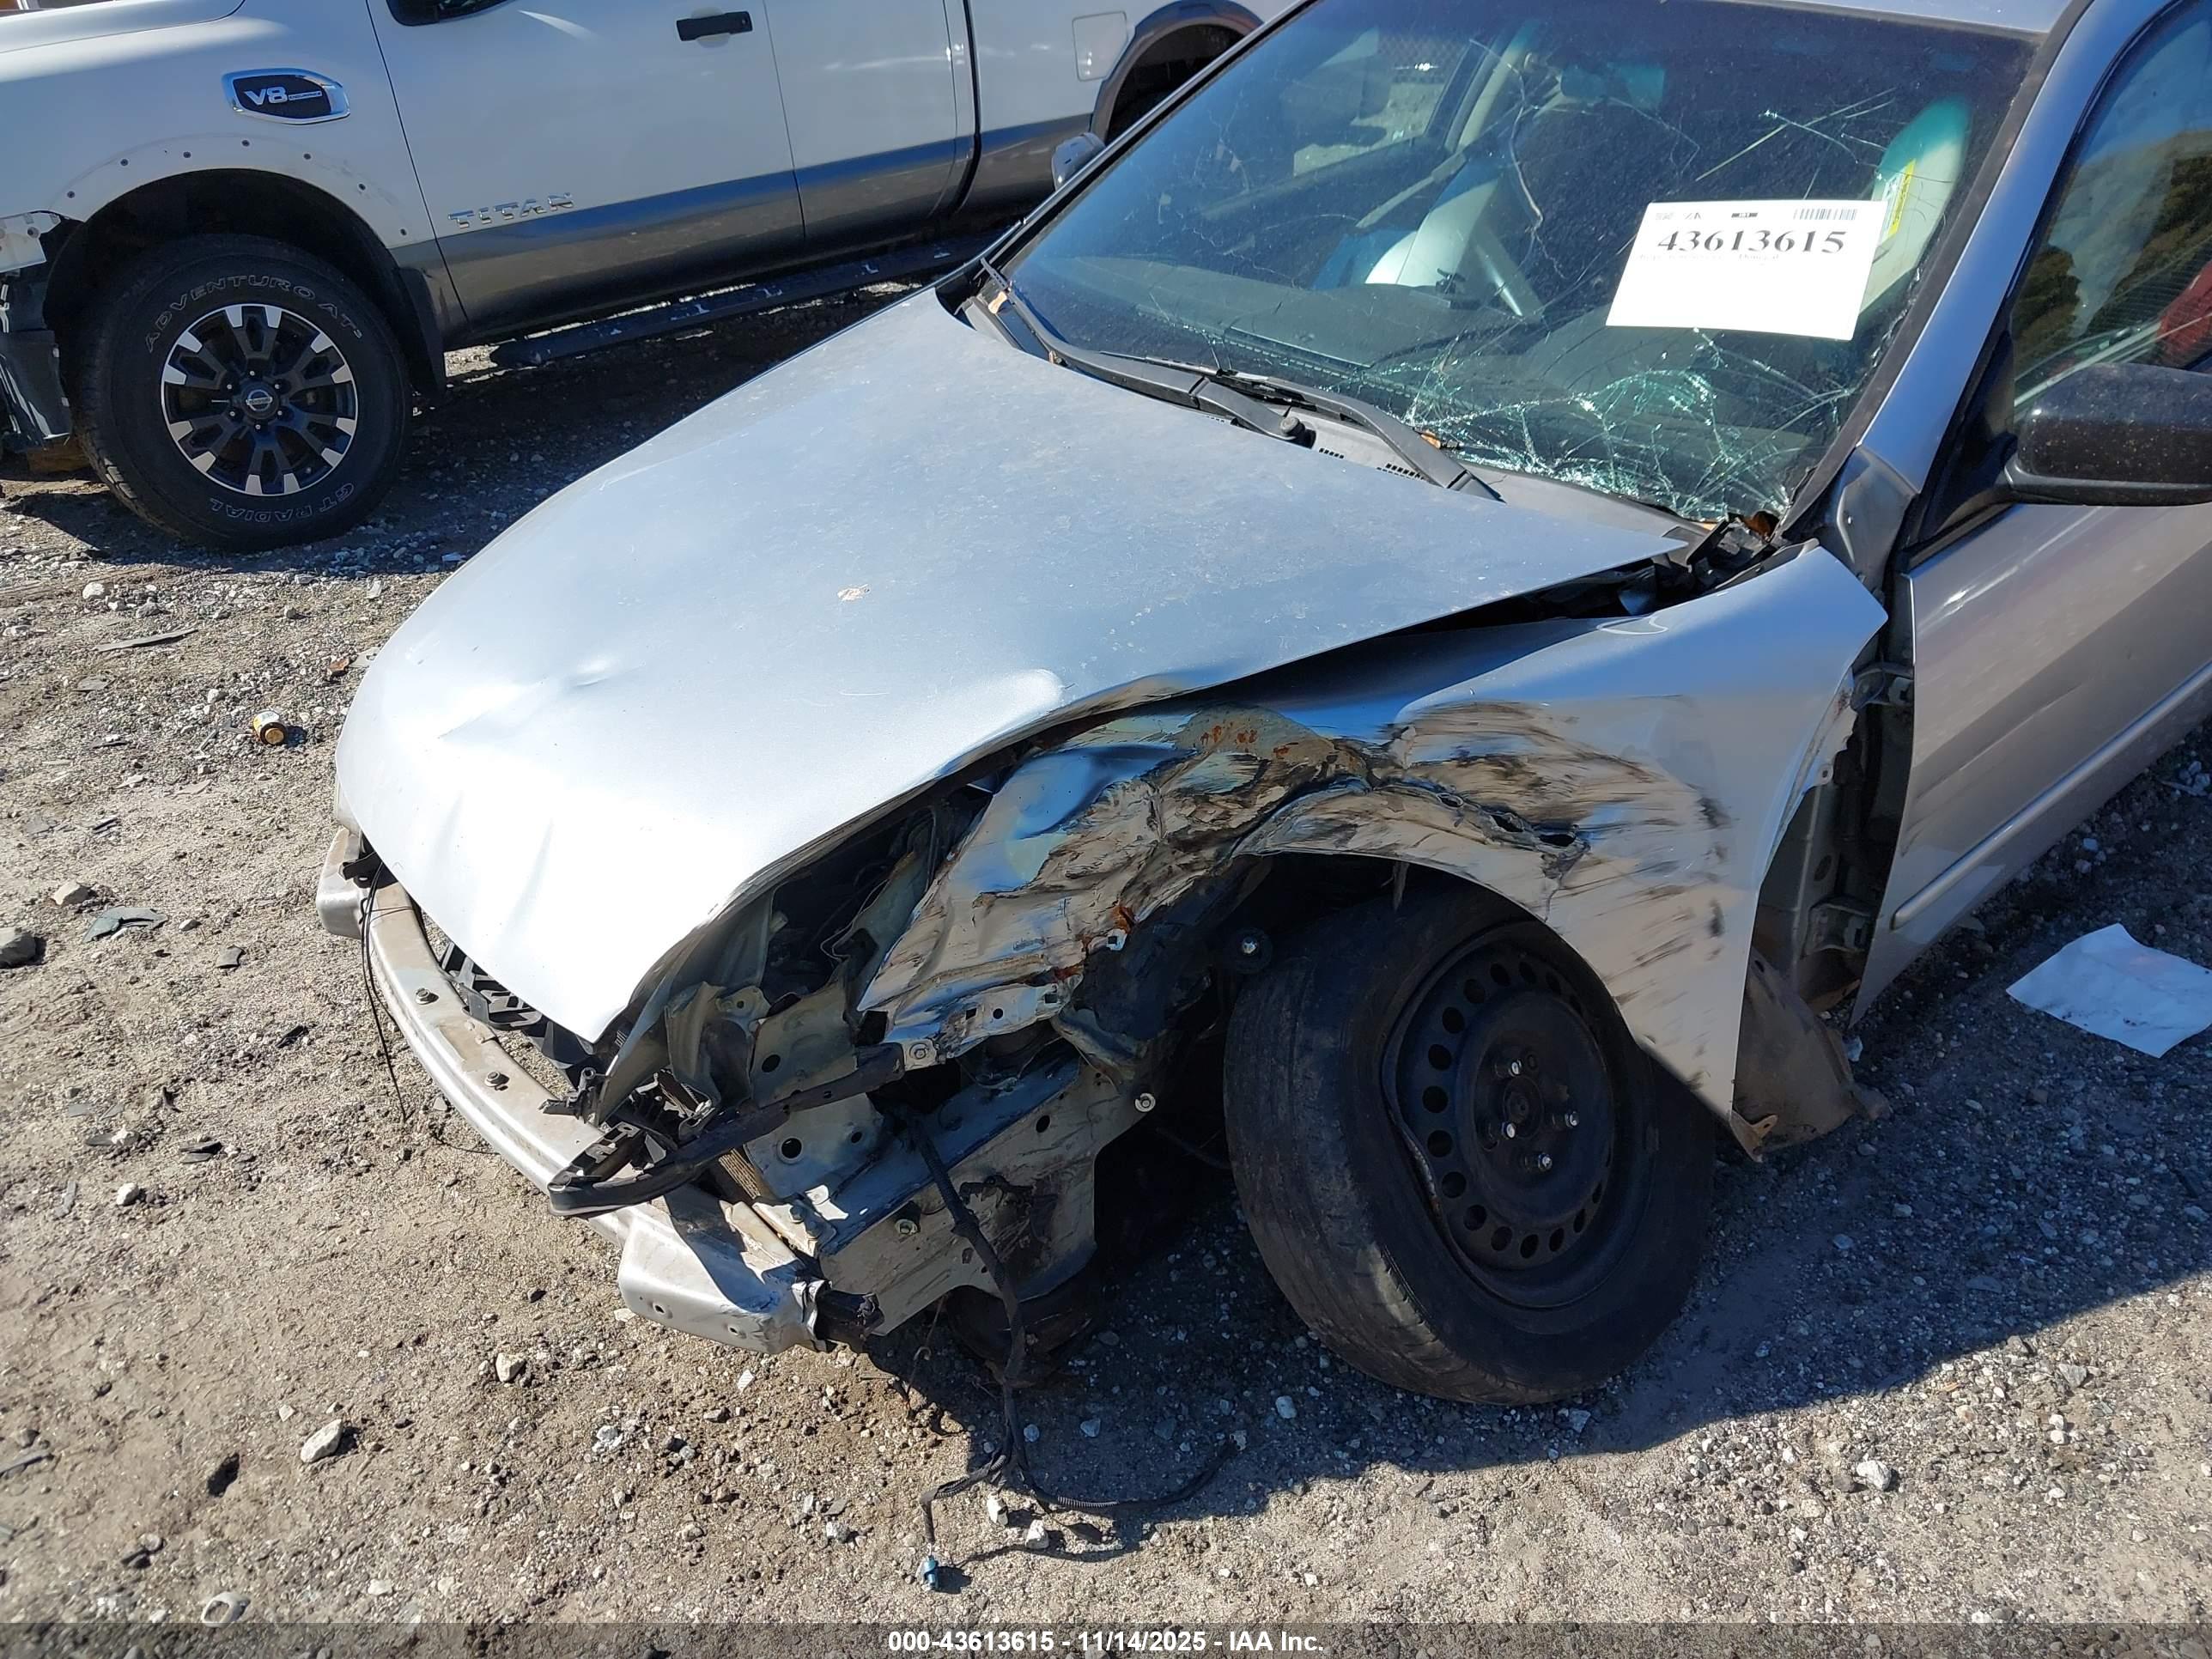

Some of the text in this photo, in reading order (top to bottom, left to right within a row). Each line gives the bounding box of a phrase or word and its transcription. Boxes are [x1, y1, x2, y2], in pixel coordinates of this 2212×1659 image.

[244, 86, 289, 106] V8
[447, 191, 574, 229] TITAN
[1657, 229, 1847, 254] 43613615
[145, 275, 317, 353] ADVENTURO
[209, 483, 354, 523] GT RADIAL
